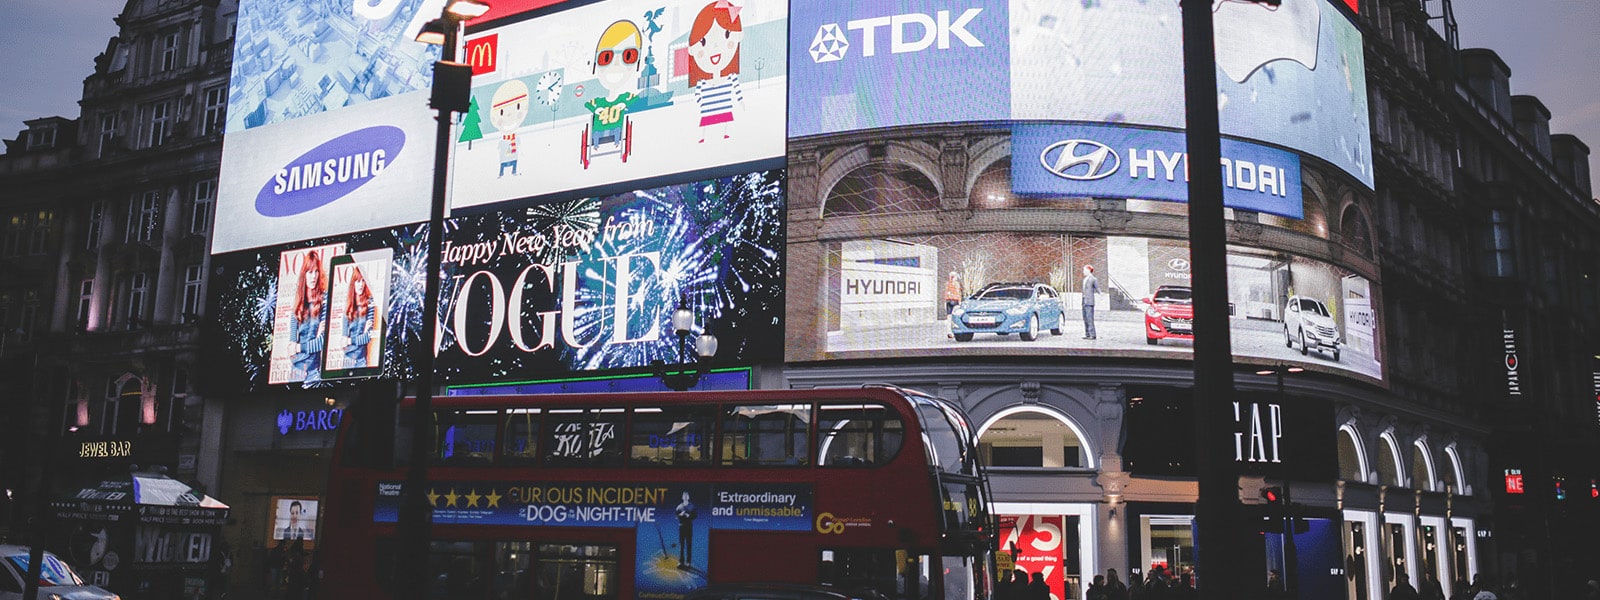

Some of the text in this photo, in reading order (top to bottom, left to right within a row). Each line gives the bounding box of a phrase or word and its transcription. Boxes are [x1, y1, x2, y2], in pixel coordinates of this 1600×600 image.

[847, 8, 985, 57] TDK
[598, 104, 621, 125] 40
[274, 149, 386, 195] SAMSUNG
[1129, 148, 1286, 197] HYNDAI
[441, 216, 654, 267] Happy New Year from
[846, 278, 921, 295] HYUNDAI
[79, 441, 131, 458] JEWEL BAR
[379, 483, 402, 491] National
[508, 487, 668, 505] CURIOUS INCIDENT
[526, 505, 567, 523] DOG
[576, 506, 656, 523] NIGHT-TIME
[712, 505, 733, 516] and
[968, 497, 977, 518] 88
[816, 512, 845, 535] Go
[135, 526, 212, 563] WICKED
[1044, 555, 1058, 563] thing
